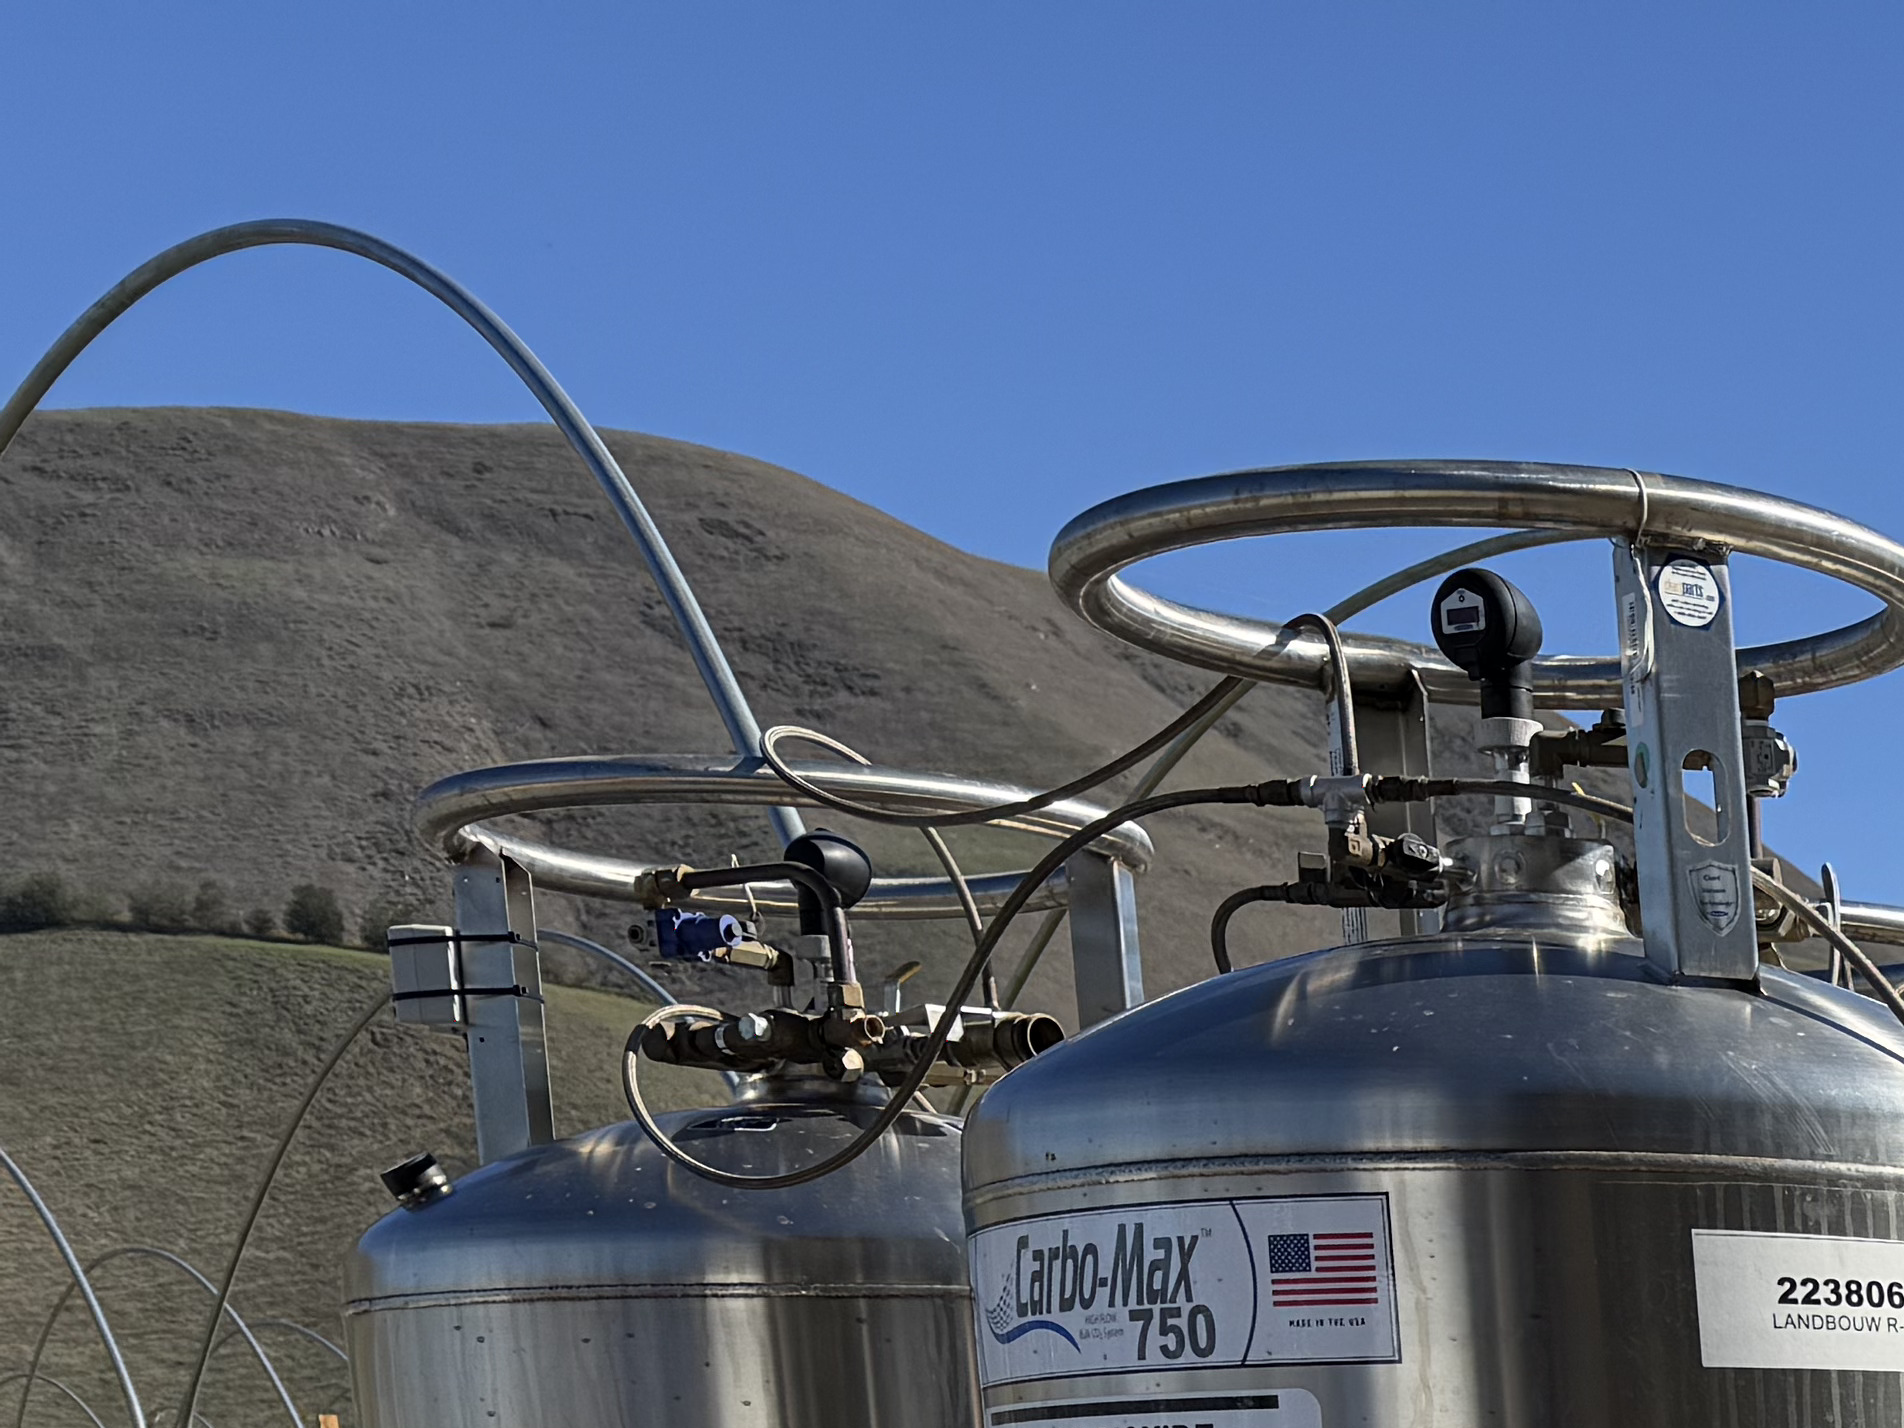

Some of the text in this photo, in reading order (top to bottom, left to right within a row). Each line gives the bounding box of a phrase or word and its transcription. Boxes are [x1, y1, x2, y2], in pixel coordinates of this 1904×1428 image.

[1776, 1276, 1904, 1309] 223806
[1128, 1304, 1216, 1361] 750
[1328, 1317, 1345, 1327] THE
[1773, 1313, 1882, 1332] LANDBOUW
